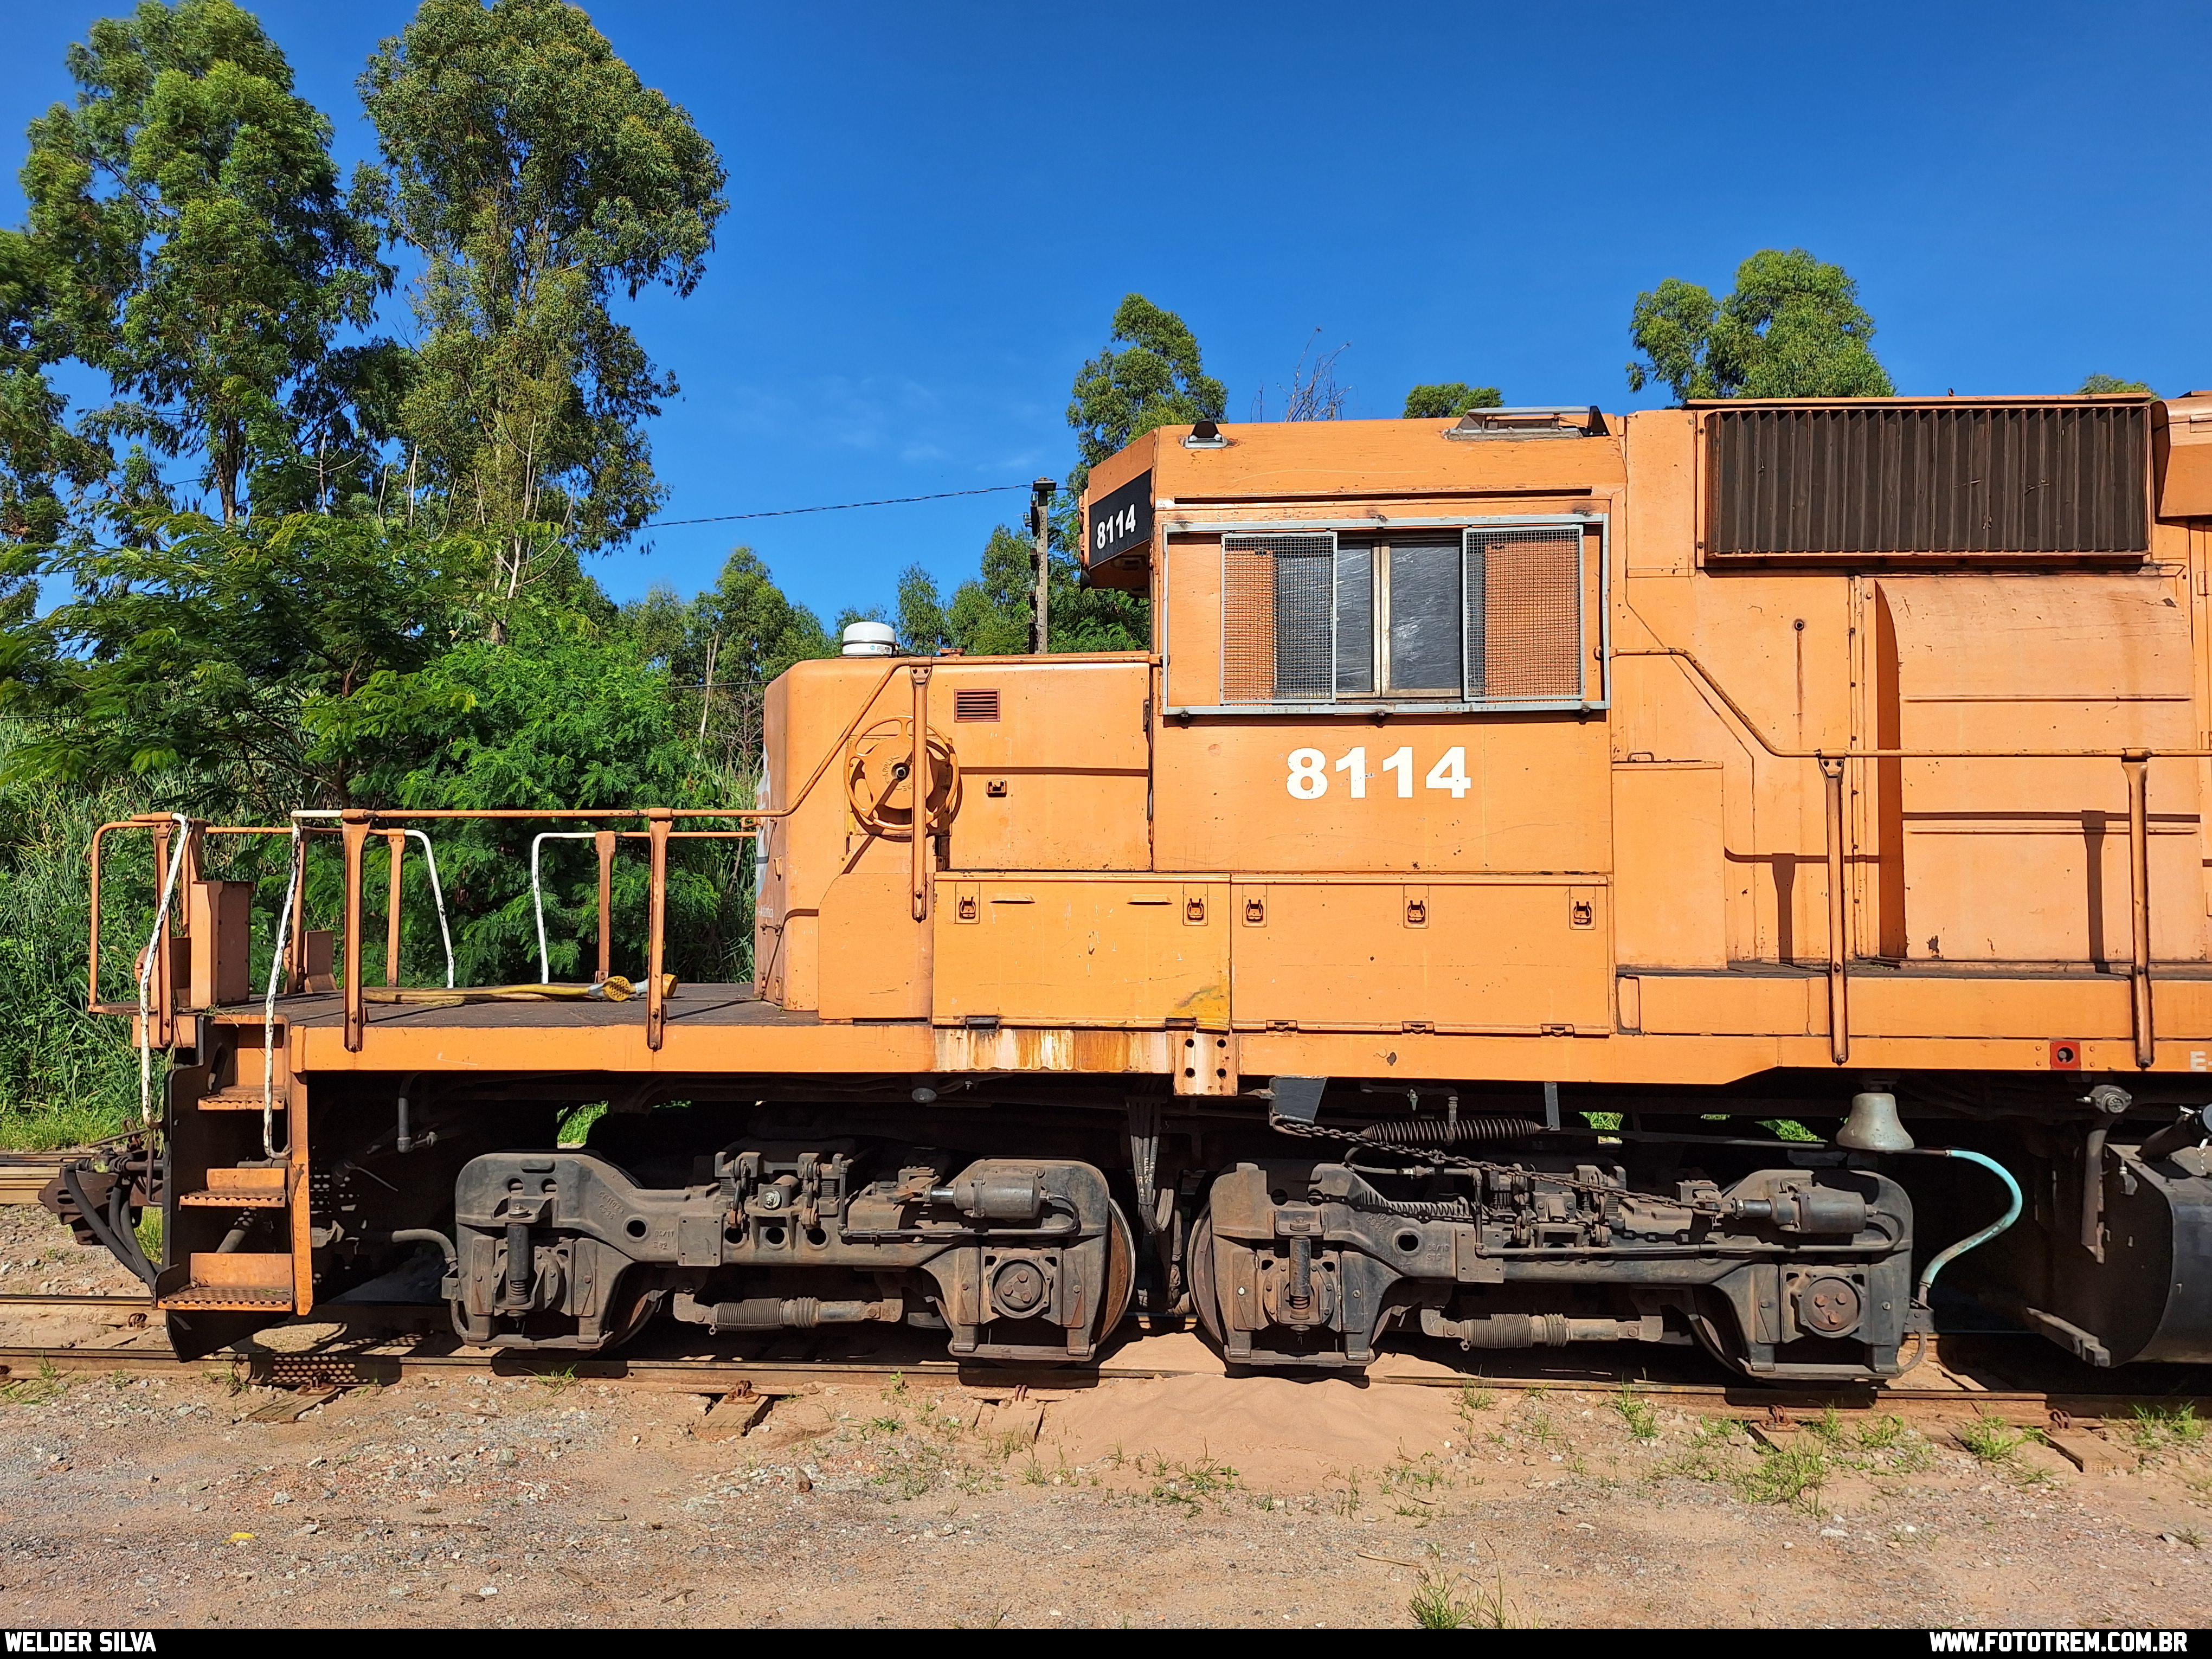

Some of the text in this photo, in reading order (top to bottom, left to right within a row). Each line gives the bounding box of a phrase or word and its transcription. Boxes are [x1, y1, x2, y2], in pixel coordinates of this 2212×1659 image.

[1097, 504, 1135, 549] 8114
[1287, 747, 1471, 799] 8114
[2190, 1050, 2212, 1072] E
